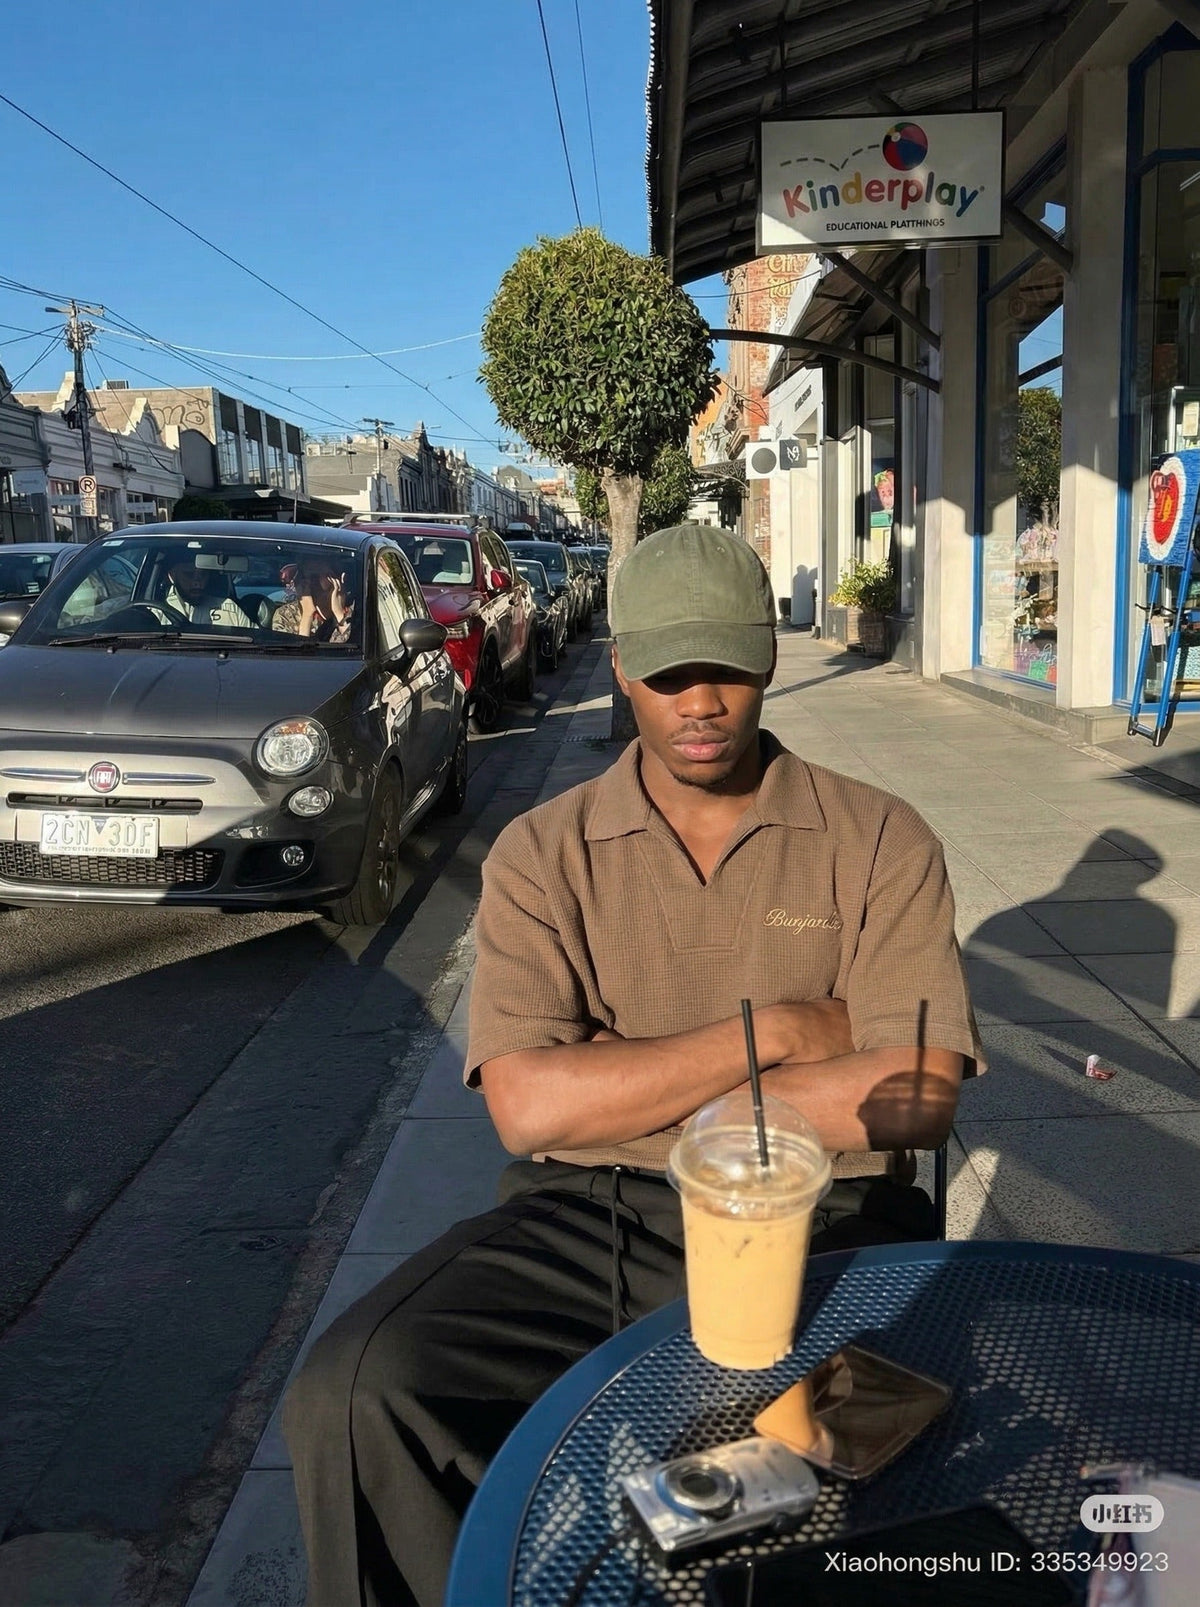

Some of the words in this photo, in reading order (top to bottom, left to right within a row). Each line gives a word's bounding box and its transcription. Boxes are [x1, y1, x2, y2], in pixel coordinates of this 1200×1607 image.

[782, 171, 979, 218] Kinderplay
[825, 221, 888, 232] EDUCATIONAL
[890, 218, 945, 229] PLATTHINGS
[45, 819, 90, 845] 2CN
